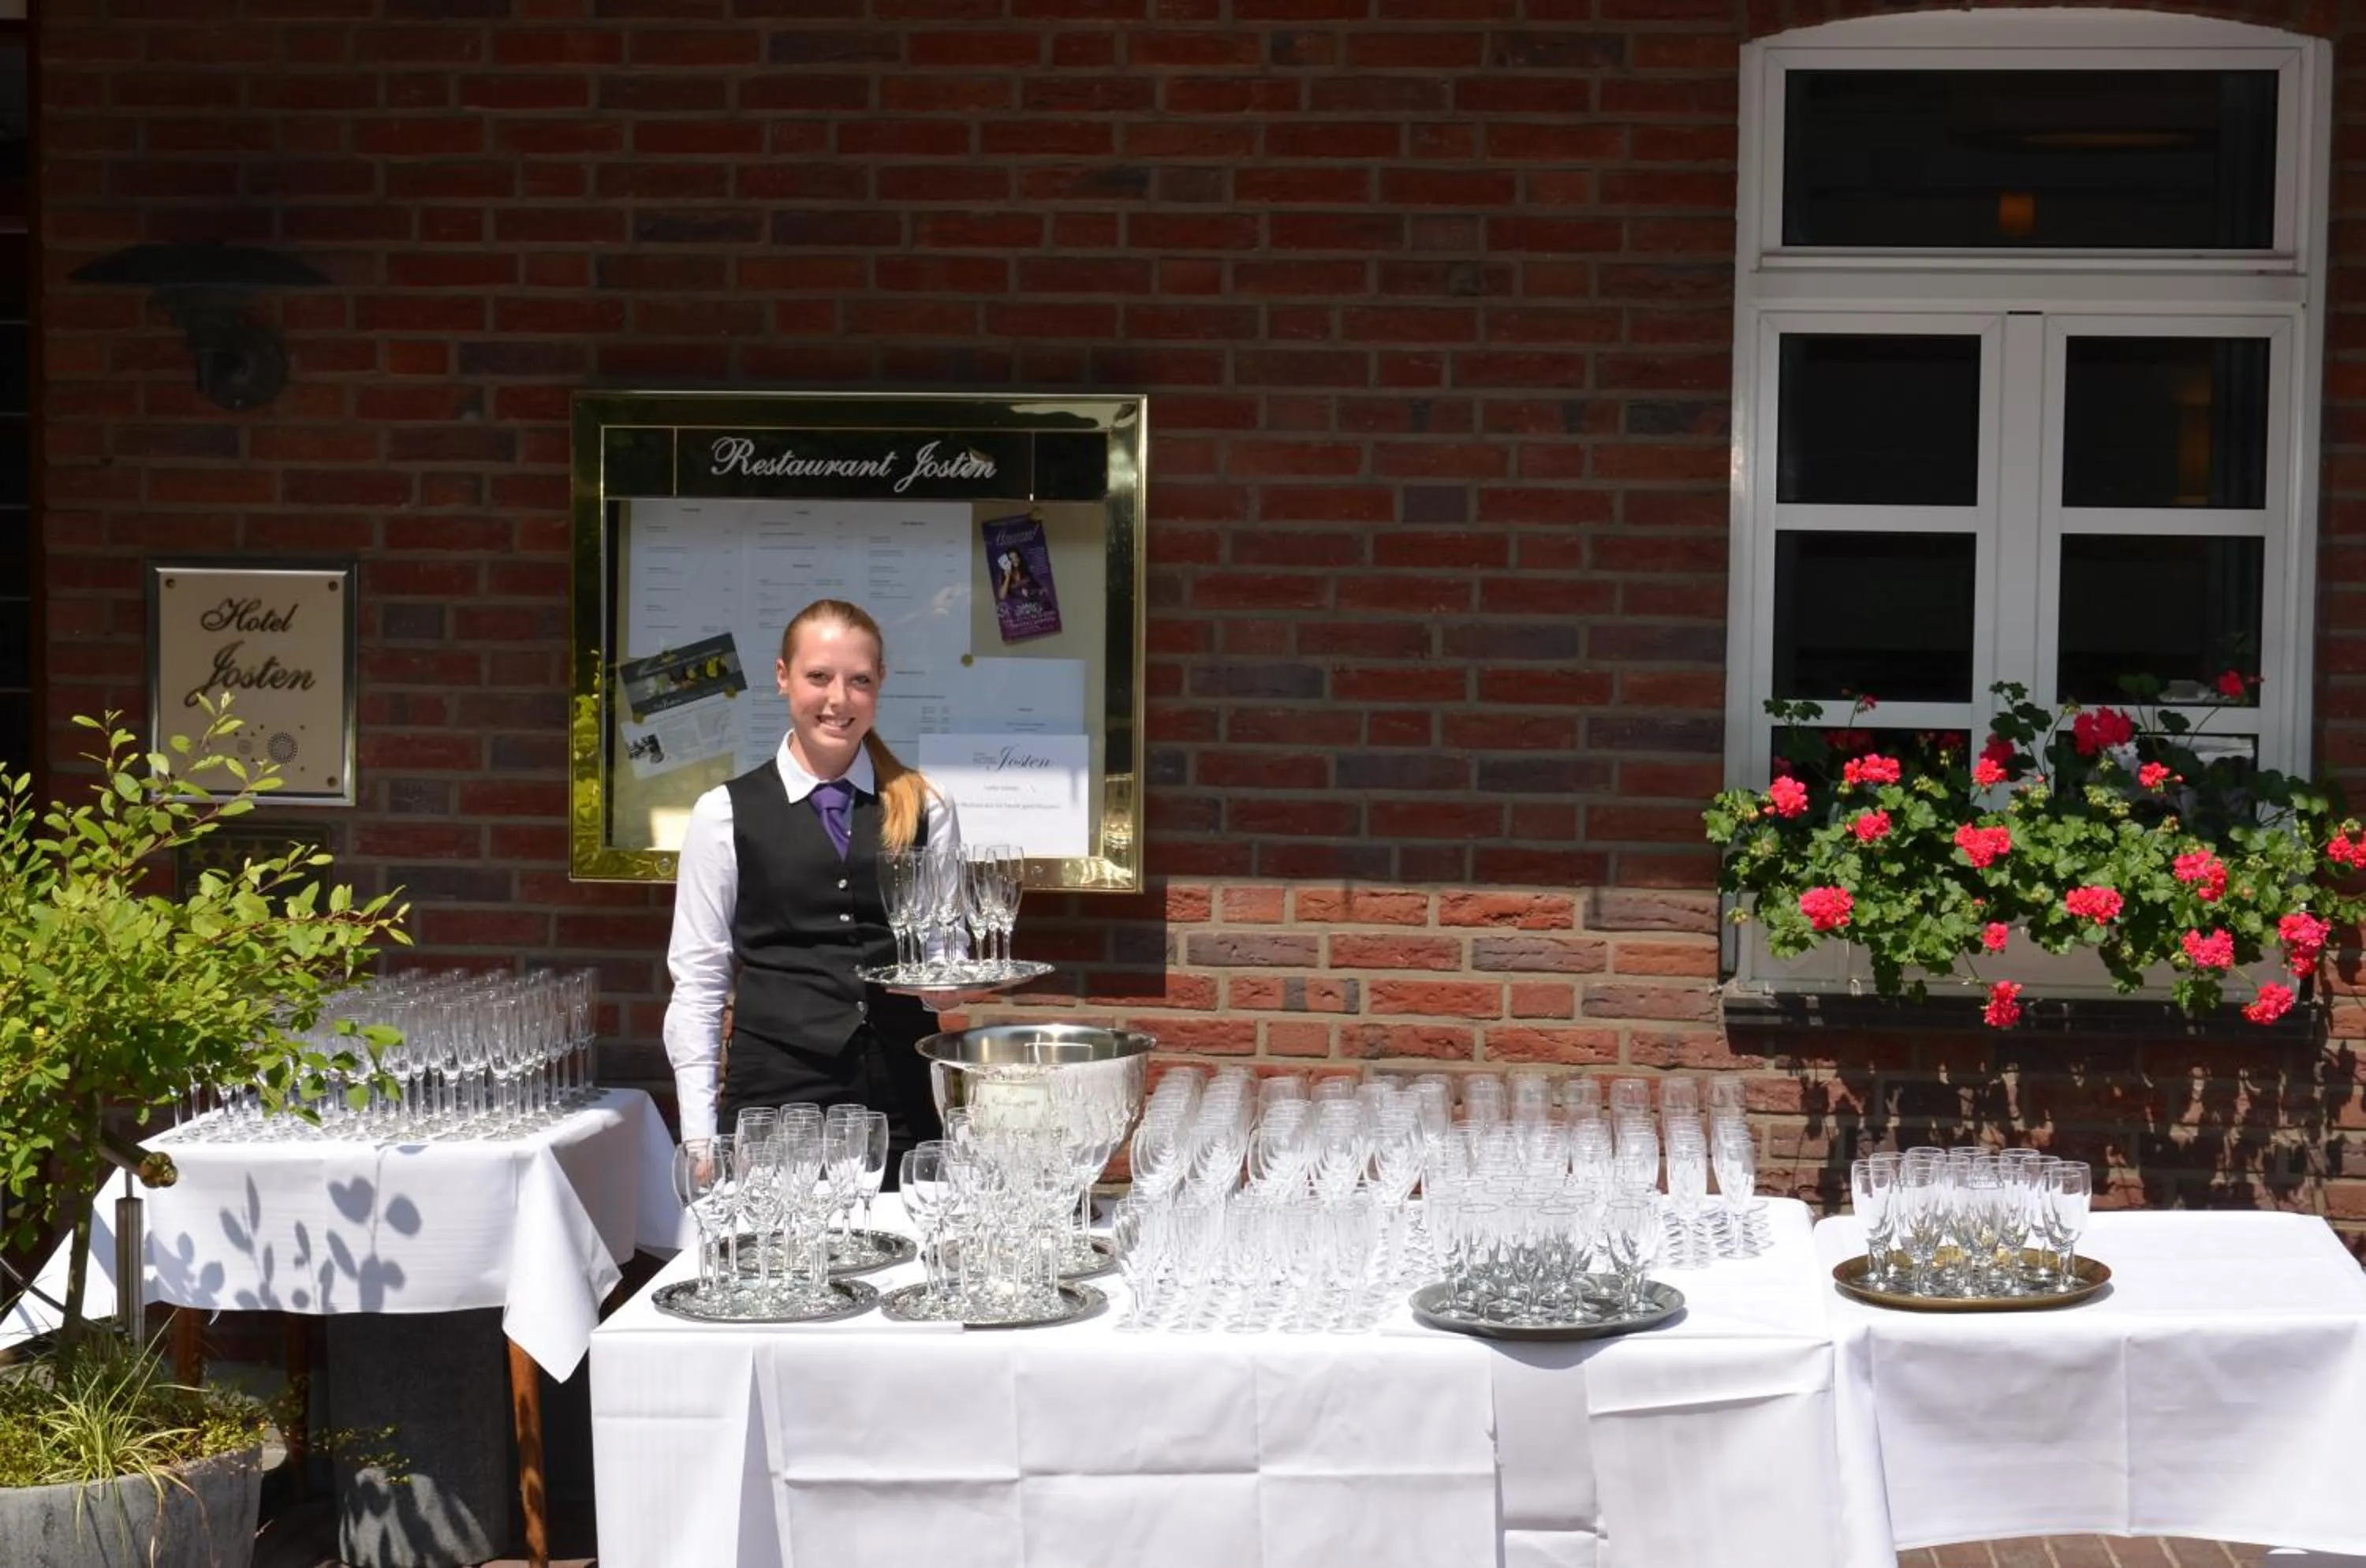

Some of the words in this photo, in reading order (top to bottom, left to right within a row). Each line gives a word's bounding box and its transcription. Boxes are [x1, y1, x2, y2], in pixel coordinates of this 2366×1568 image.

[711, 435, 899, 479] Restaurant
[893, 440, 997, 494] Josten
[200, 597, 299, 633] Hotel
[184, 640, 316, 707] Josten
[996, 745, 1052, 771] Josten
